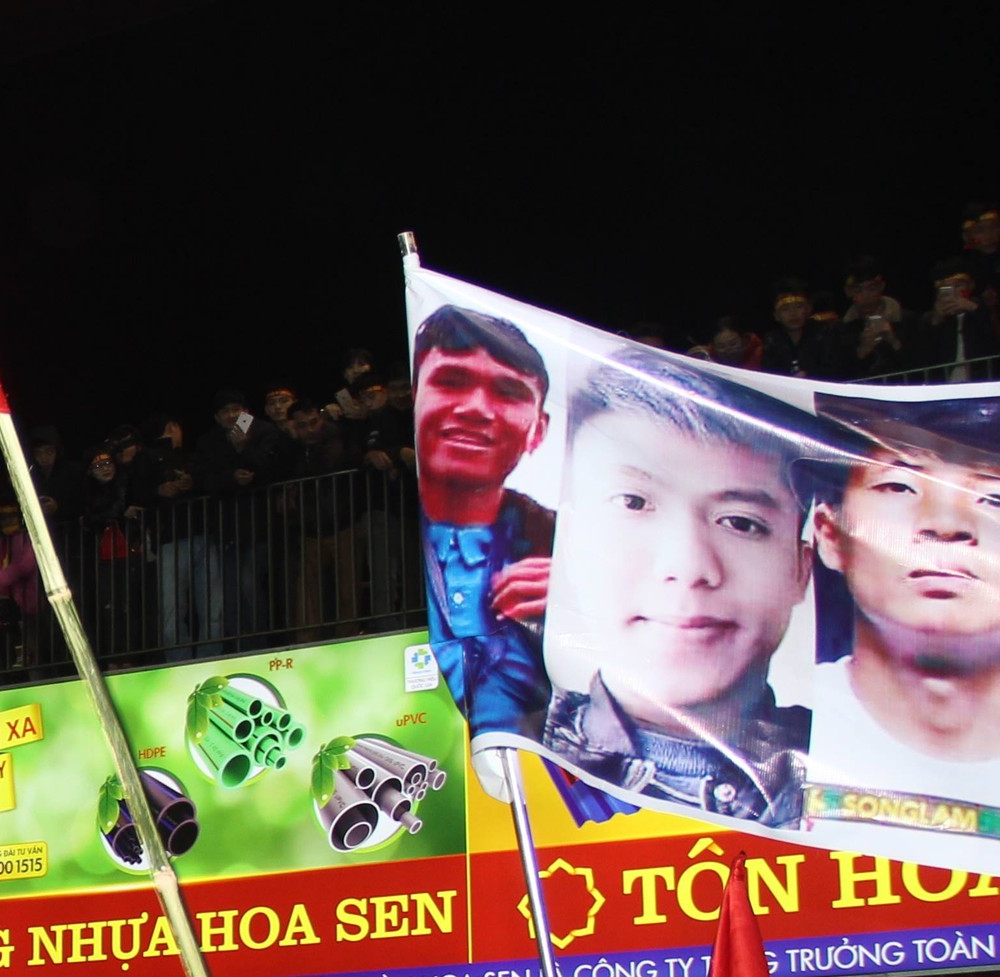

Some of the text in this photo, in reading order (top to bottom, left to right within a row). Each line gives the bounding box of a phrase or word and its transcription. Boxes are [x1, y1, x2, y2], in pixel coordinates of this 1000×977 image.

[269, 658, 294, 671] PP-R
[6, 716, 37, 742] XA
[138, 746, 166, 760] HDPE
[16, 857, 43, 873] 1515
[622, 837, 805, 926] TÔN
[27, 911, 181, 971] NHỰA
[196, 903, 321, 953] HOA
[335, 890, 457, 942] SEN
[786, 937, 905, 973] TRƯỞNG
[912, 931, 996, 964] TOÀN
